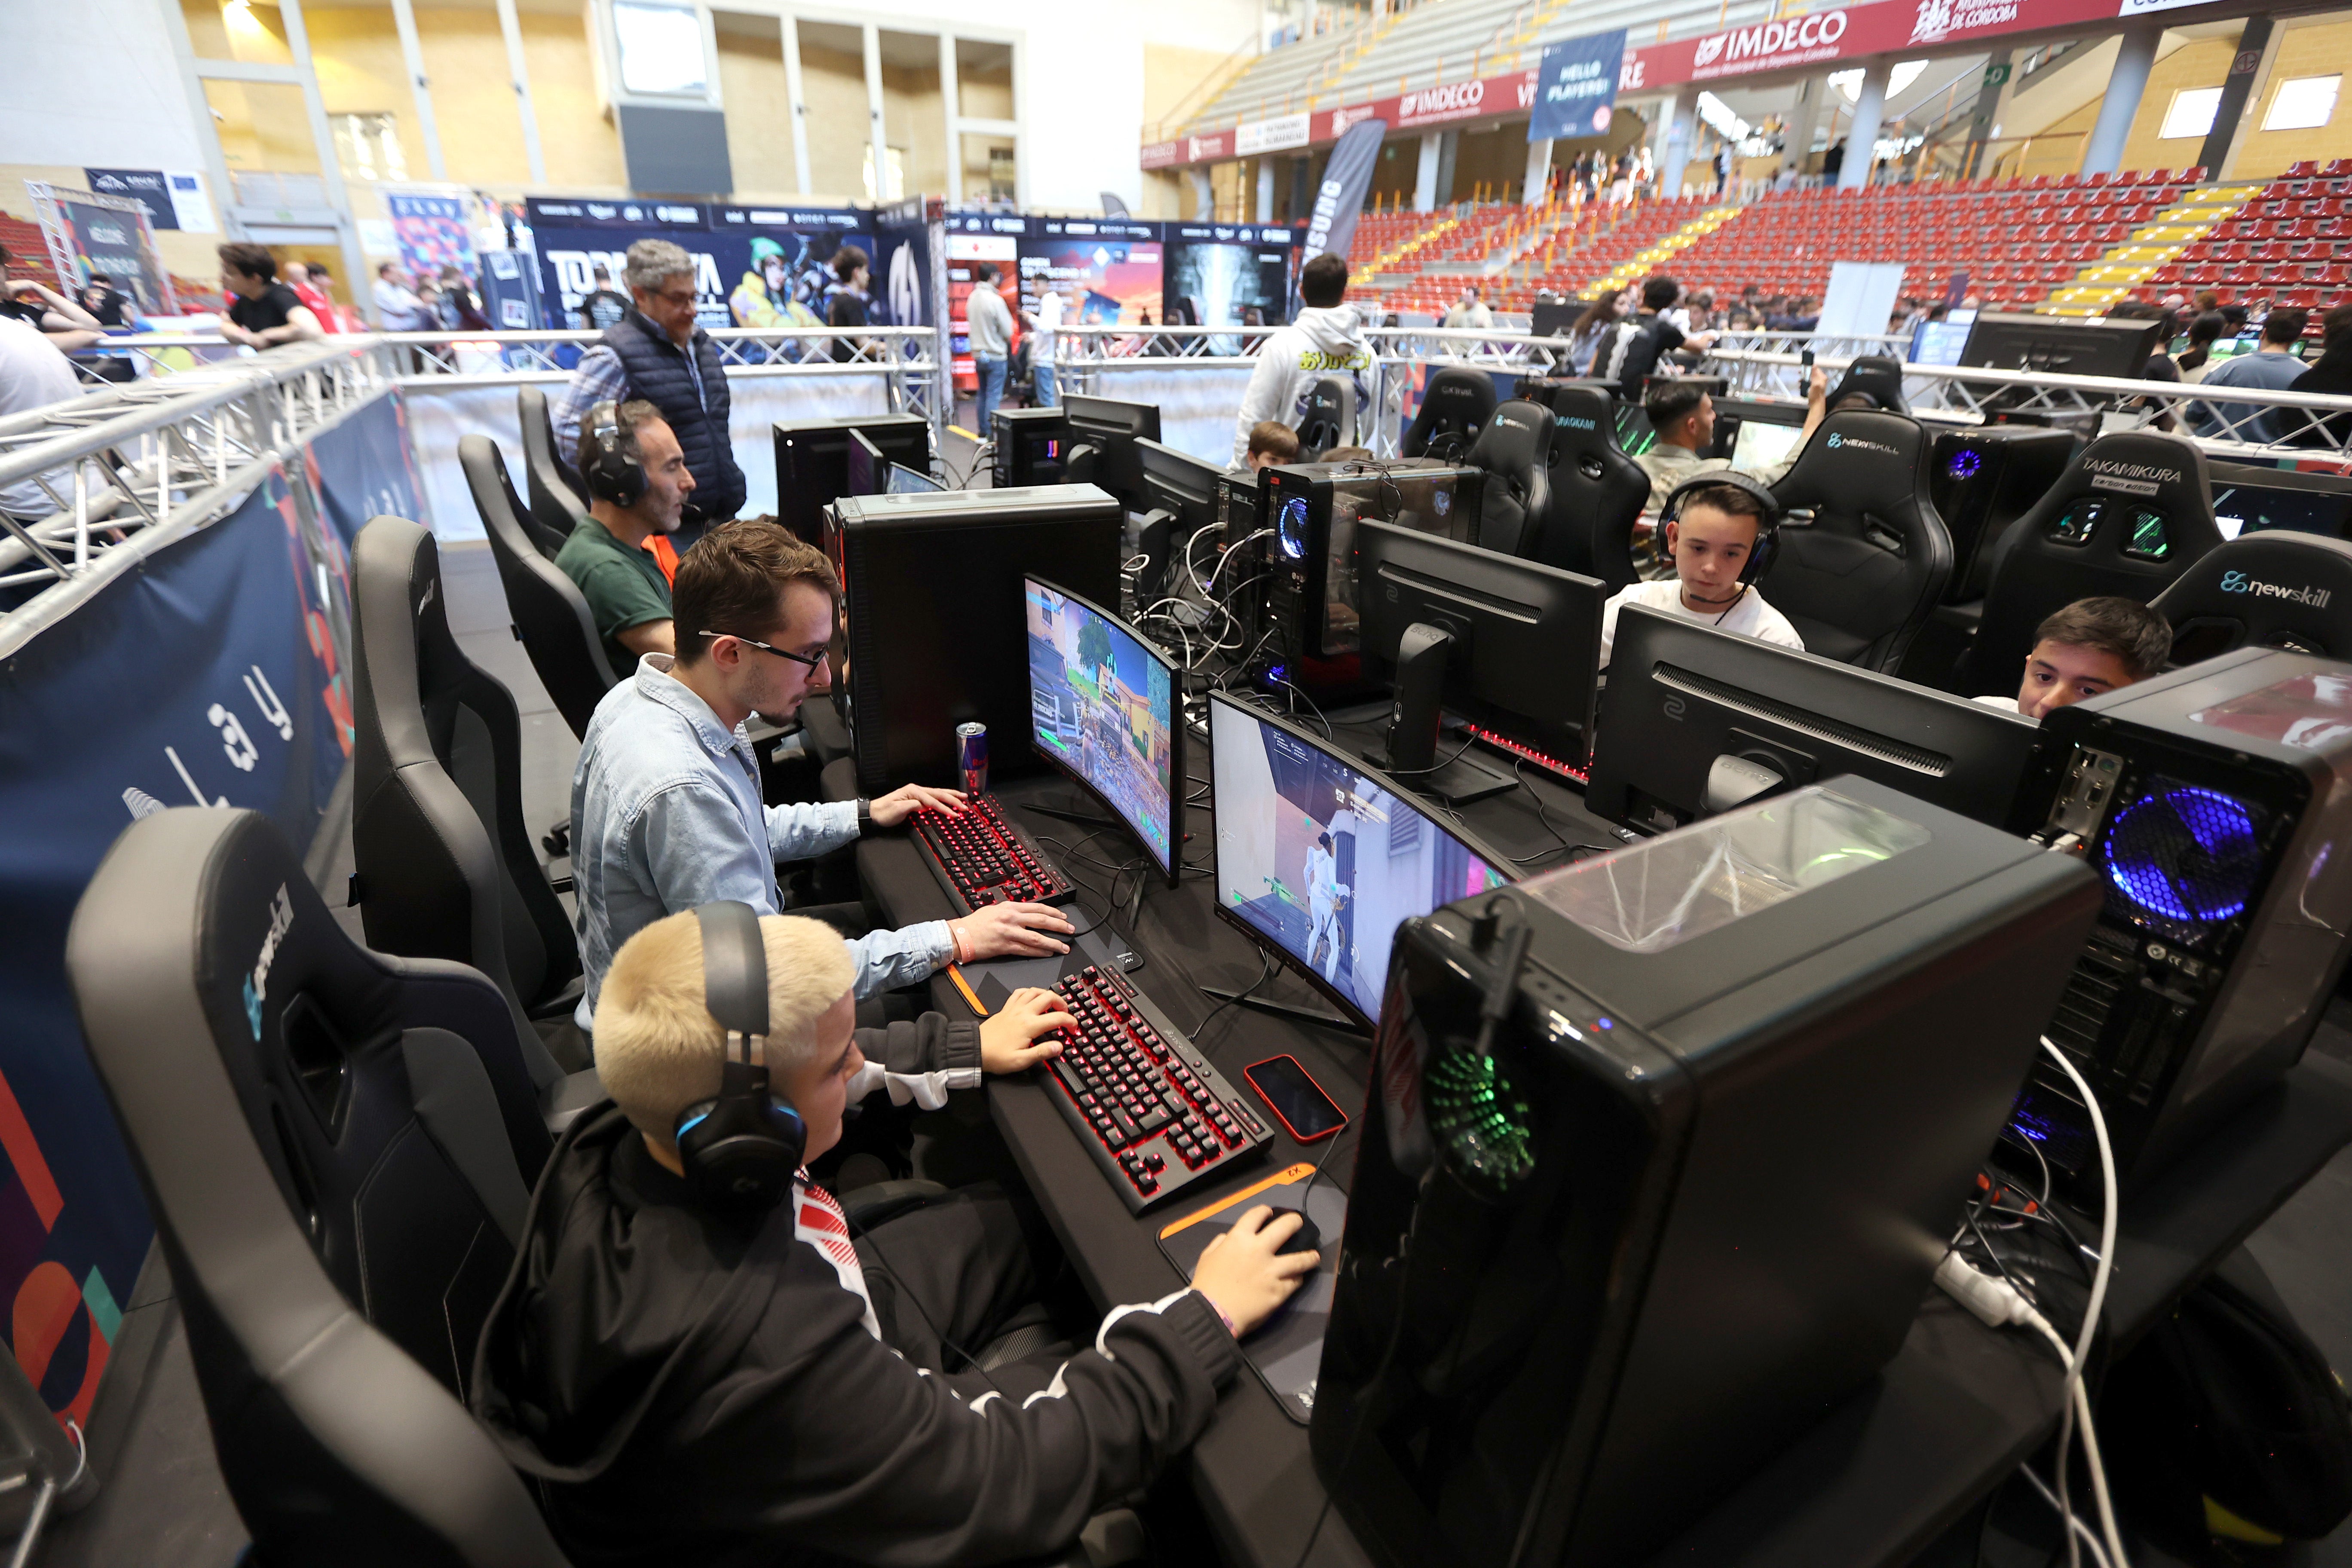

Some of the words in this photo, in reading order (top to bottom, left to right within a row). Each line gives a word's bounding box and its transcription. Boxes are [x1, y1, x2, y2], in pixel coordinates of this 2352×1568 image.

[1725, 10, 1847, 61] IMDECO
[1560, 60, 1601, 83] HELLO
[1417, 80, 1484, 115] IMDECO
[1841, 438, 1899, 455] NEWSKILL
[2083, 457, 2182, 483] TAKAMIKURA
[2095, 478, 2124, 488] carbon
[2125, 483, 2156, 492] edition
[2248, 580, 2331, 608] newskill
[1343, 768, 1348, 777] S
